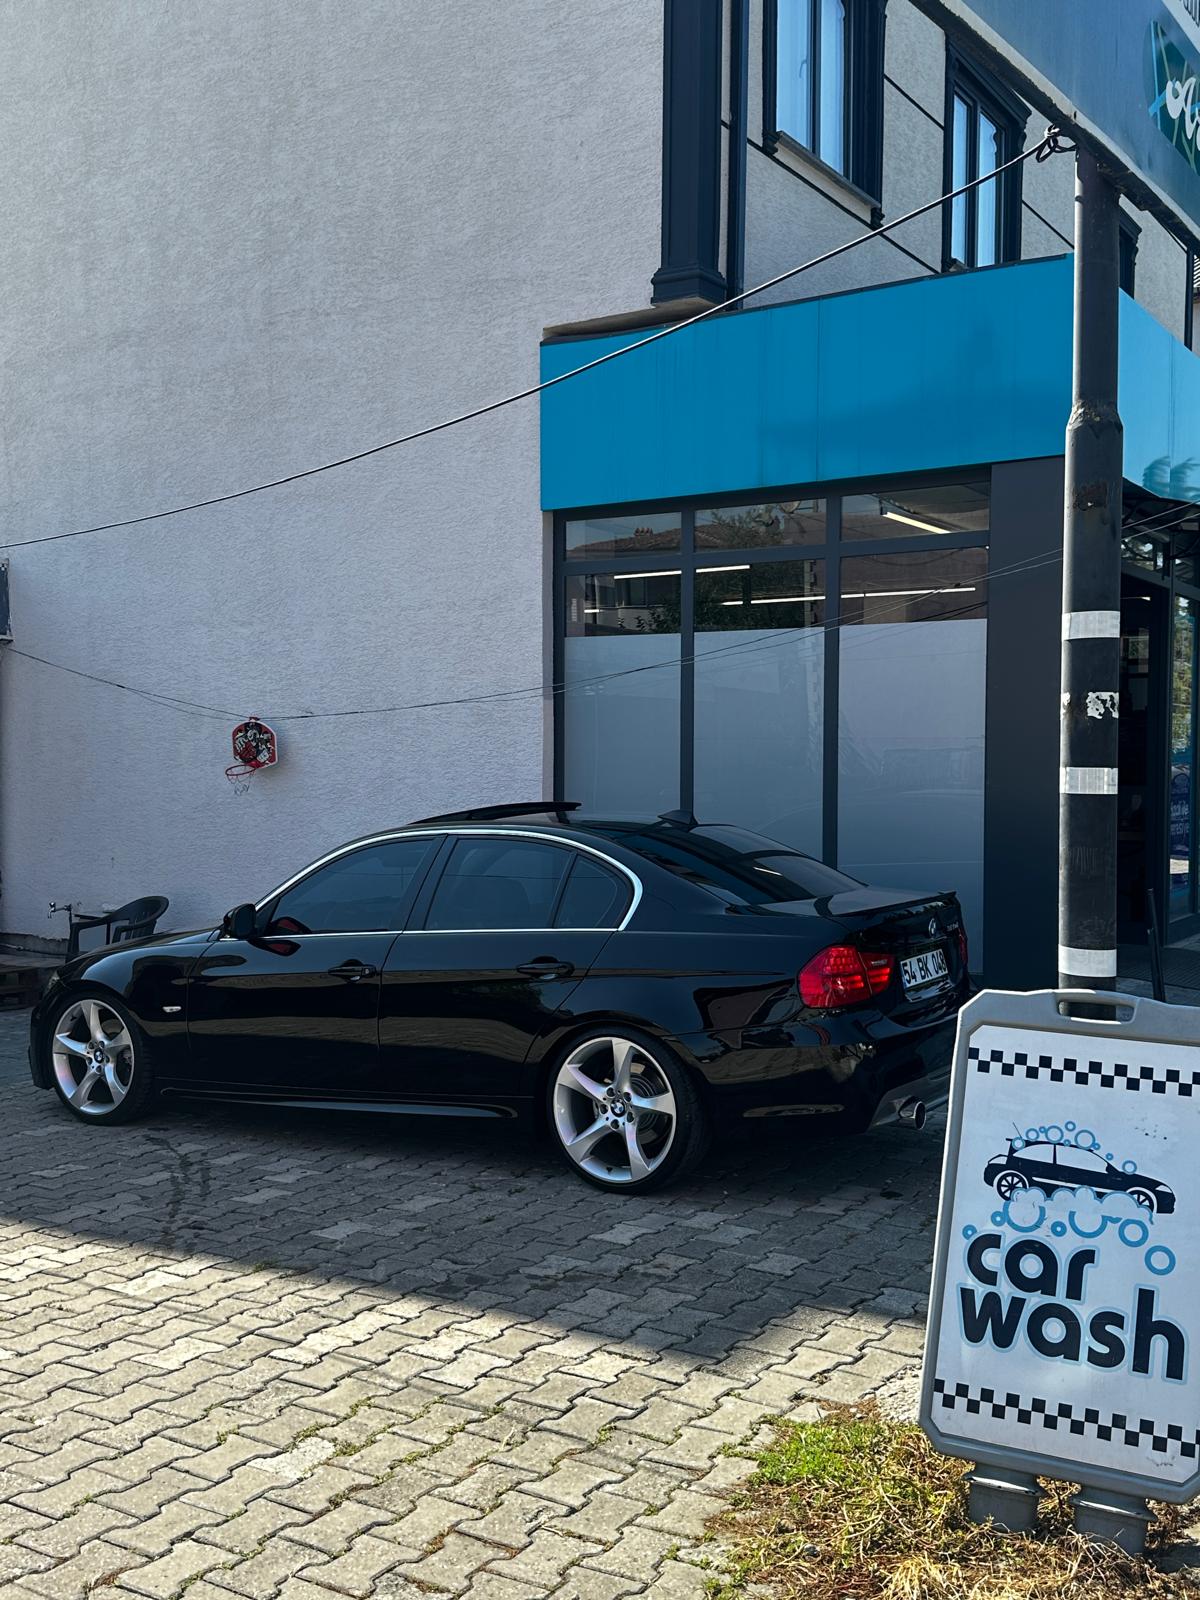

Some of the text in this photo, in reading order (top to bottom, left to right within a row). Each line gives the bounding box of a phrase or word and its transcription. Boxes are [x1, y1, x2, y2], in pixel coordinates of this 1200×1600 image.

[902, 961, 917, 984] 54
[917, 955, 932, 980] BK
[967, 1233, 1096, 1301] car
[960, 1287, 1186, 1382] wash
